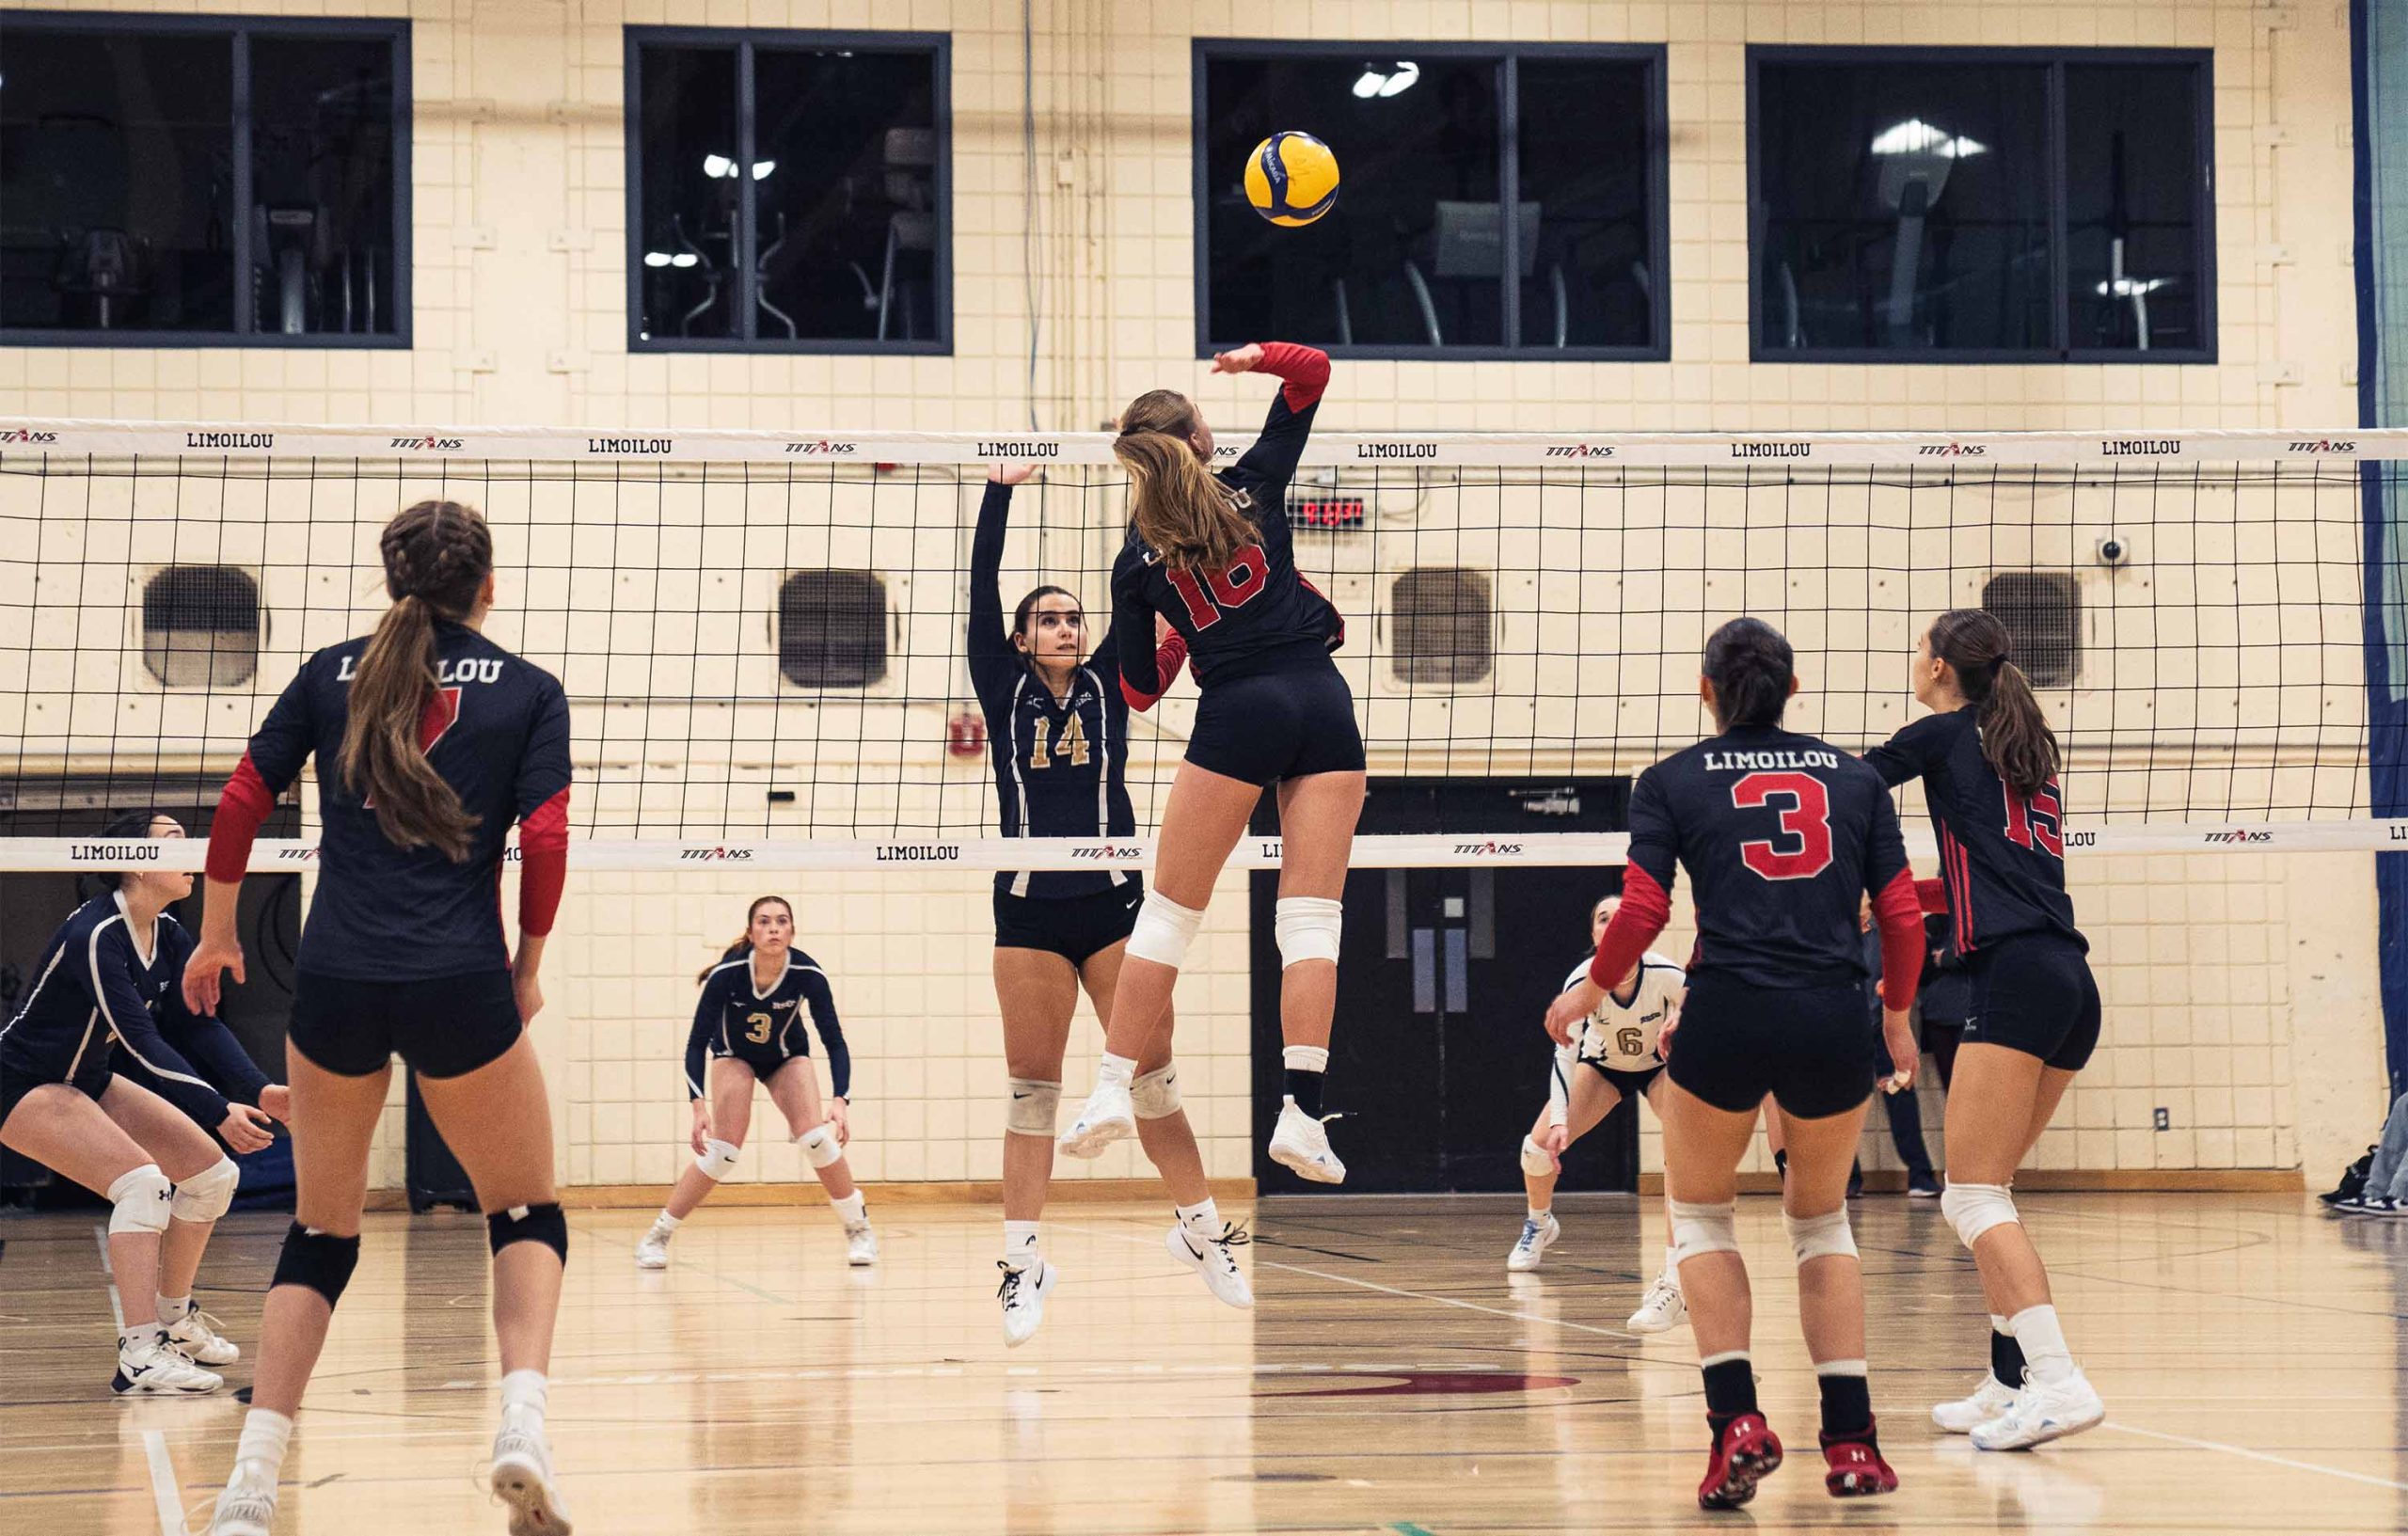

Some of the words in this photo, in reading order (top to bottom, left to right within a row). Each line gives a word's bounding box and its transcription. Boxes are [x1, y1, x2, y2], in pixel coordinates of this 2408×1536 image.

[0, 430, 58, 443] TANS
[187, 433, 274, 449] LIMOILOU
[390, 435, 464, 450] TITANS
[589, 438, 672, 454] LIMOILOU
[785, 440, 857, 453] TITANS
[978, 442, 1059, 457] LIMOILOU
[1357, 444, 1437, 458] LIMOILOU
[1545, 444, 1616, 458] TITANS
[1732, 443, 1811, 457] LIMOILOU
[1919, 444, 1988, 457] TITANS
[2102, 440, 2181, 455] LIMOILOU
[2289, 440, 2356, 453] TITANS
[337, 656, 503, 684] LLOU
[1030, 709, 1090, 769] 14
[1704, 750, 1839, 771] LIMOILOU
[1731, 771, 1833, 880] 3
[2205, 830, 2273, 844] TITANS
[71, 846, 159, 861] LIMOILOU
[279, 847, 323, 862] TITA
[680, 847, 754, 861] TITANS
[877, 846, 959, 861] LIMOILOU
[1070, 846, 1143, 860] TITANS
[1453, 842, 1524, 856] TITANS
[745, 1013, 772, 1044] 3
[1616, 1027, 1643, 1056] 6
